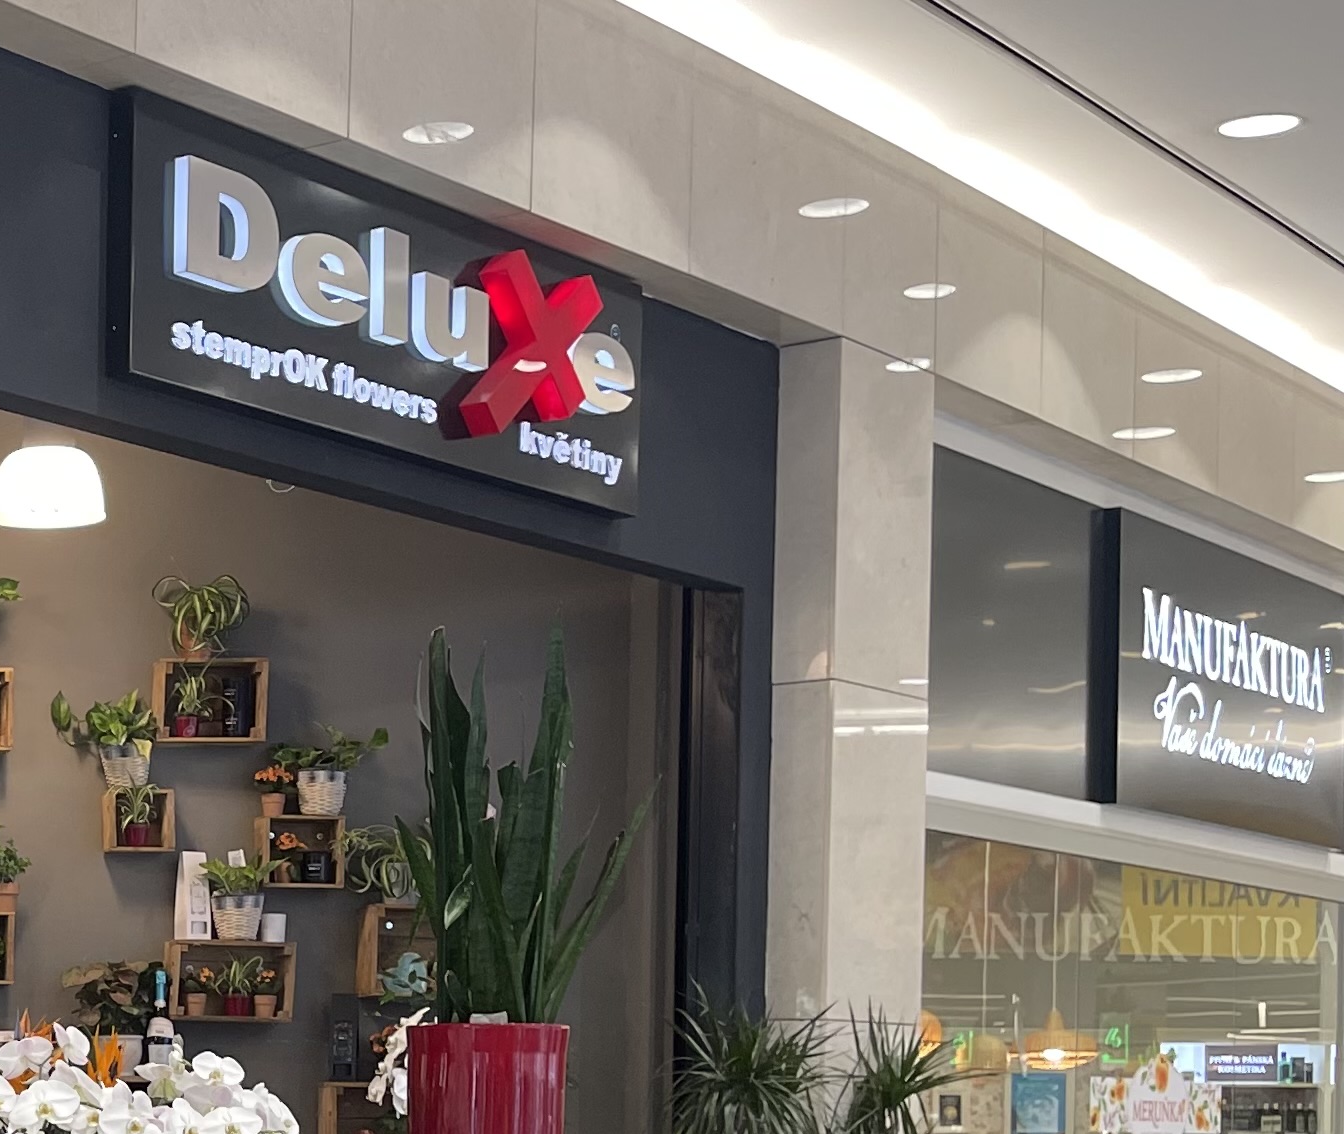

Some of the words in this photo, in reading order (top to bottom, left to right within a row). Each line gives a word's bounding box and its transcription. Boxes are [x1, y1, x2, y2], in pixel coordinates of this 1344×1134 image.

[171, 319, 330, 393] stemprOK
[330, 360, 439, 425] flowers
[518, 420, 623, 486] květiny
[1142, 586, 1326, 714] MANUFAKTURA
